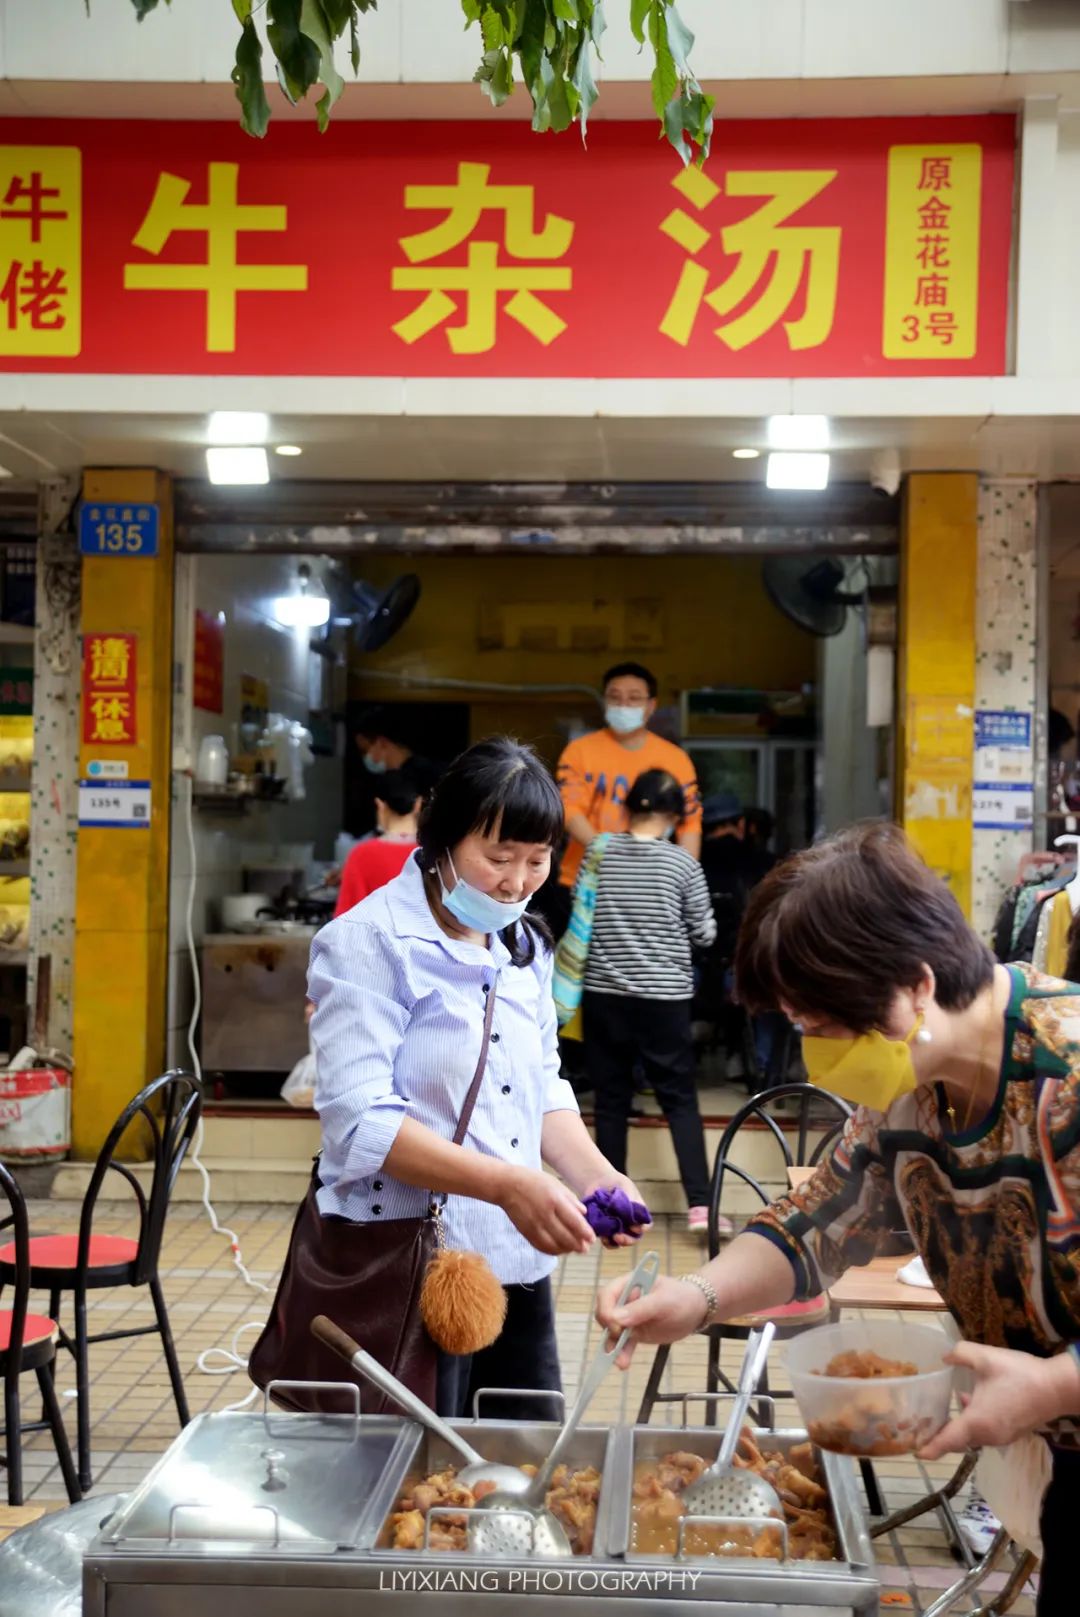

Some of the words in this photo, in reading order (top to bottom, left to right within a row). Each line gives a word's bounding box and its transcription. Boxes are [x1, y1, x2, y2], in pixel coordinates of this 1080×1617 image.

[0, 172, 68, 330] 牛佬
[123, 161, 843, 354] 牛杂汤
[96, 524, 143, 552] 135
